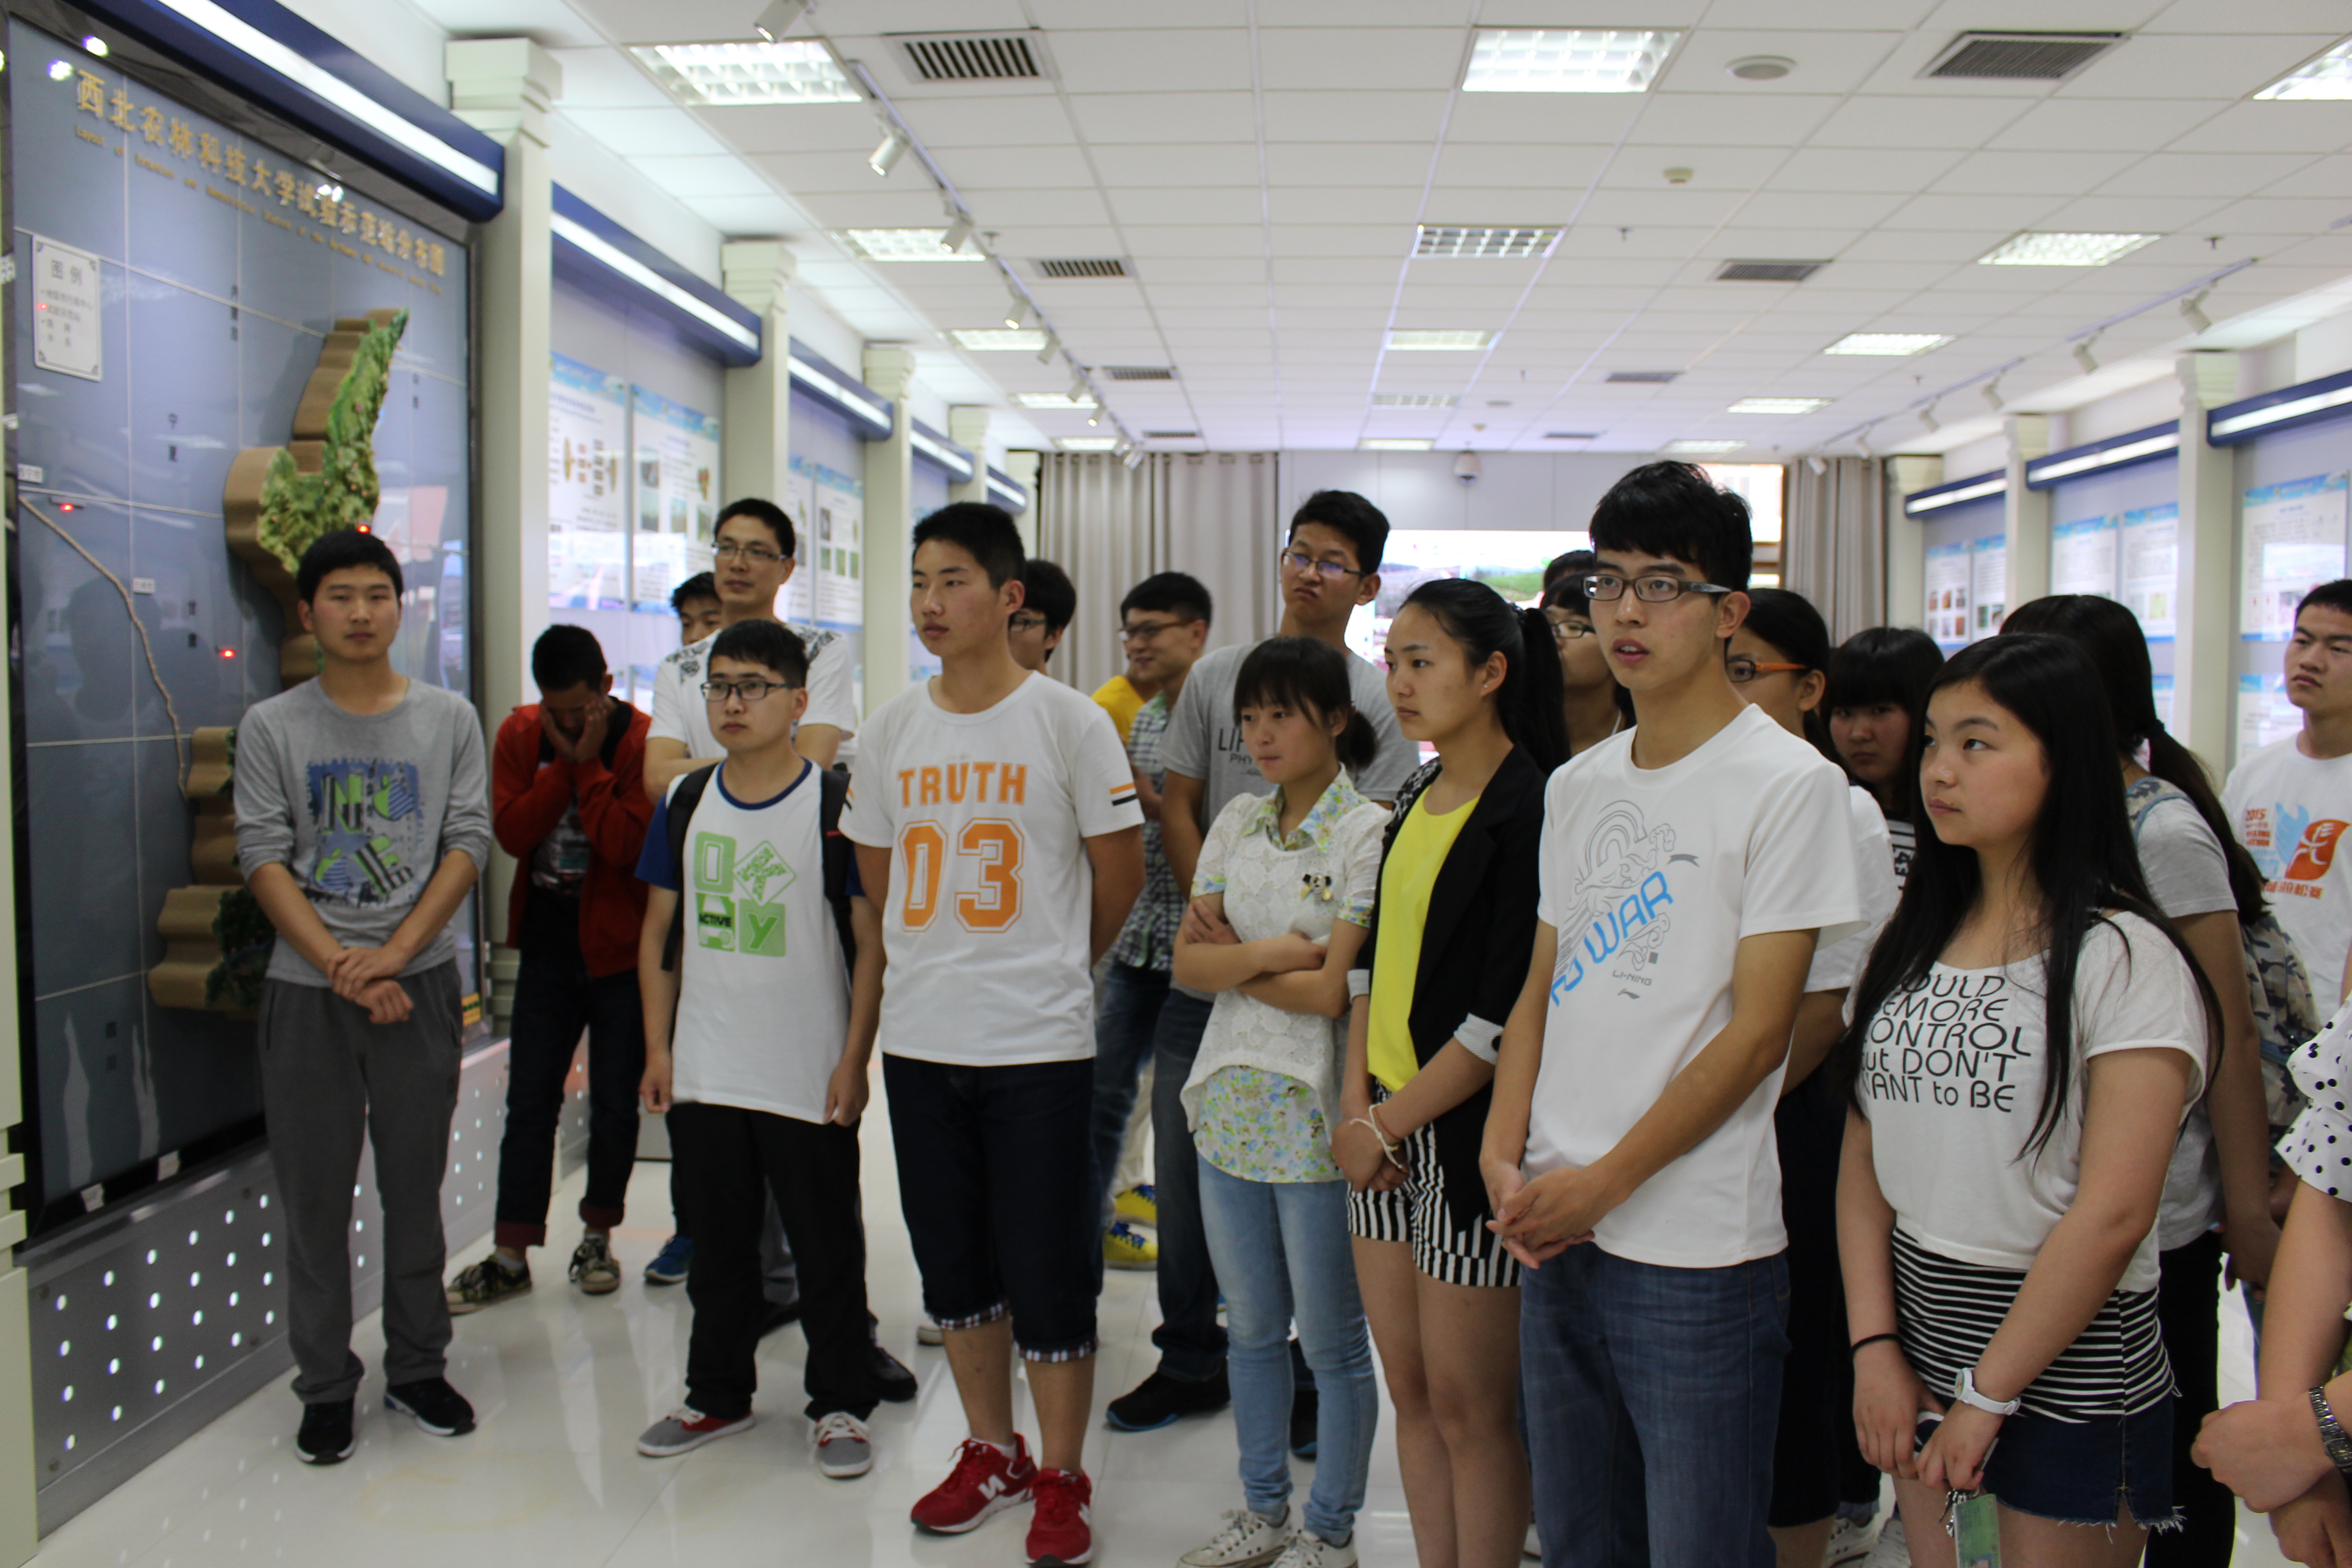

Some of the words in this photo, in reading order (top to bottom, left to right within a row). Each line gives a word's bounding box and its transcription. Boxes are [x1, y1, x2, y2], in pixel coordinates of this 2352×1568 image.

[897, 762, 1027, 808] TRUTH
[898, 817, 1024, 933] 03
[699, 914, 731, 927] ACTIVE
[1612, 970, 1653, 986] LI-NING
[1901, 972, 2005, 999] OULD
[1870, 1017, 2031, 1057] ONTROL
[1862, 1048, 1889, 1072] ut
[1902, 1048, 2017, 1082] DON'T
[1934, 1081, 1959, 1106] to
[1970, 1080, 2015, 1112] BE
